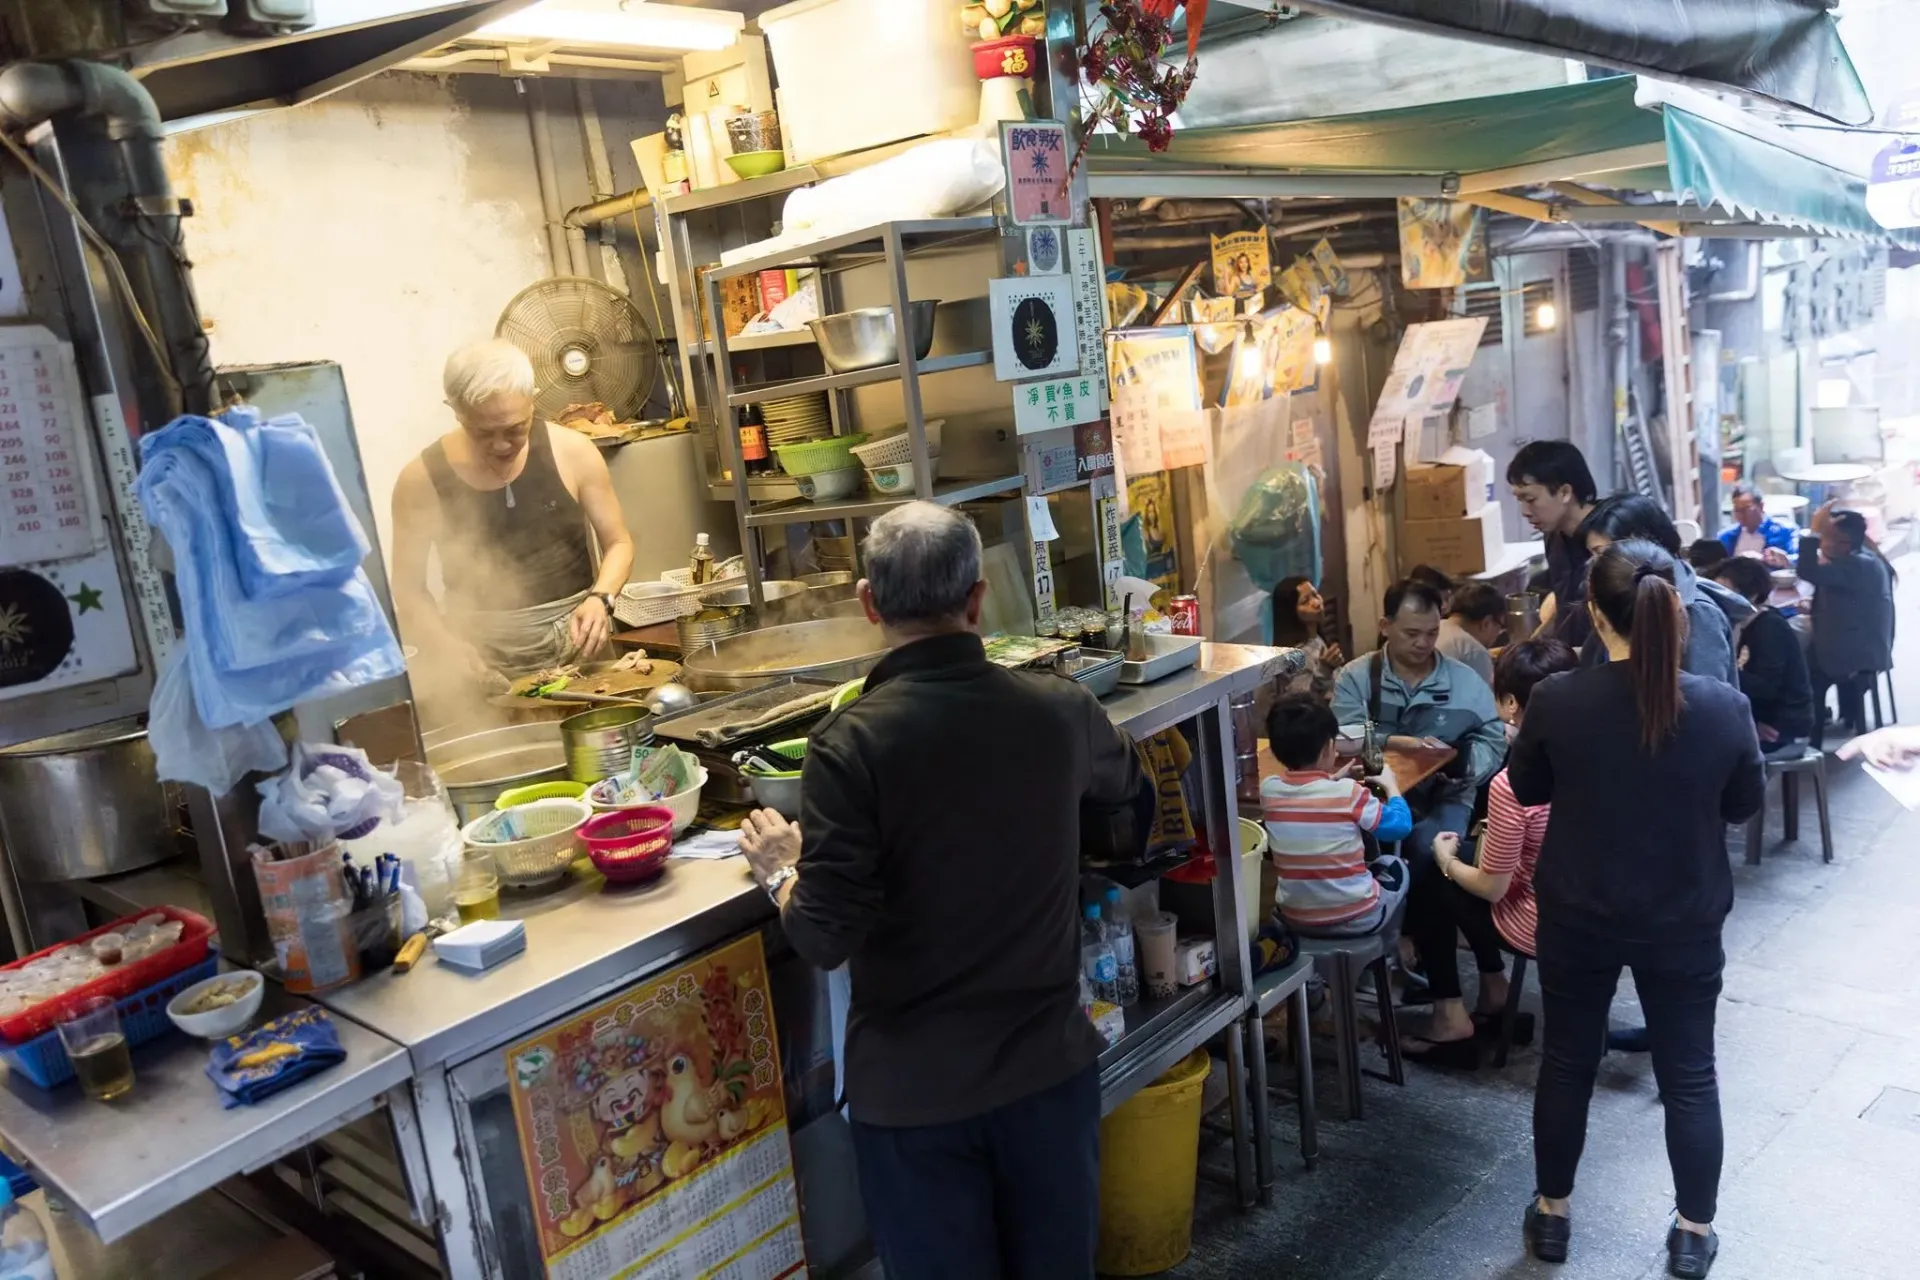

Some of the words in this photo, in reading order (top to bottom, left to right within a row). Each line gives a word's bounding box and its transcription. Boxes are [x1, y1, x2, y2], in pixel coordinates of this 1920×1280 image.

[1001, 48, 1028, 73] 福
[1011, 128, 1062, 151] 飲食男女
[45, 434, 61, 444] 90
[1109, 566, 1120, 580] 17
[1037, 575, 1050, 594] 17
[635, 748, 649, 759] 50
[622, 789, 636, 802] 50
